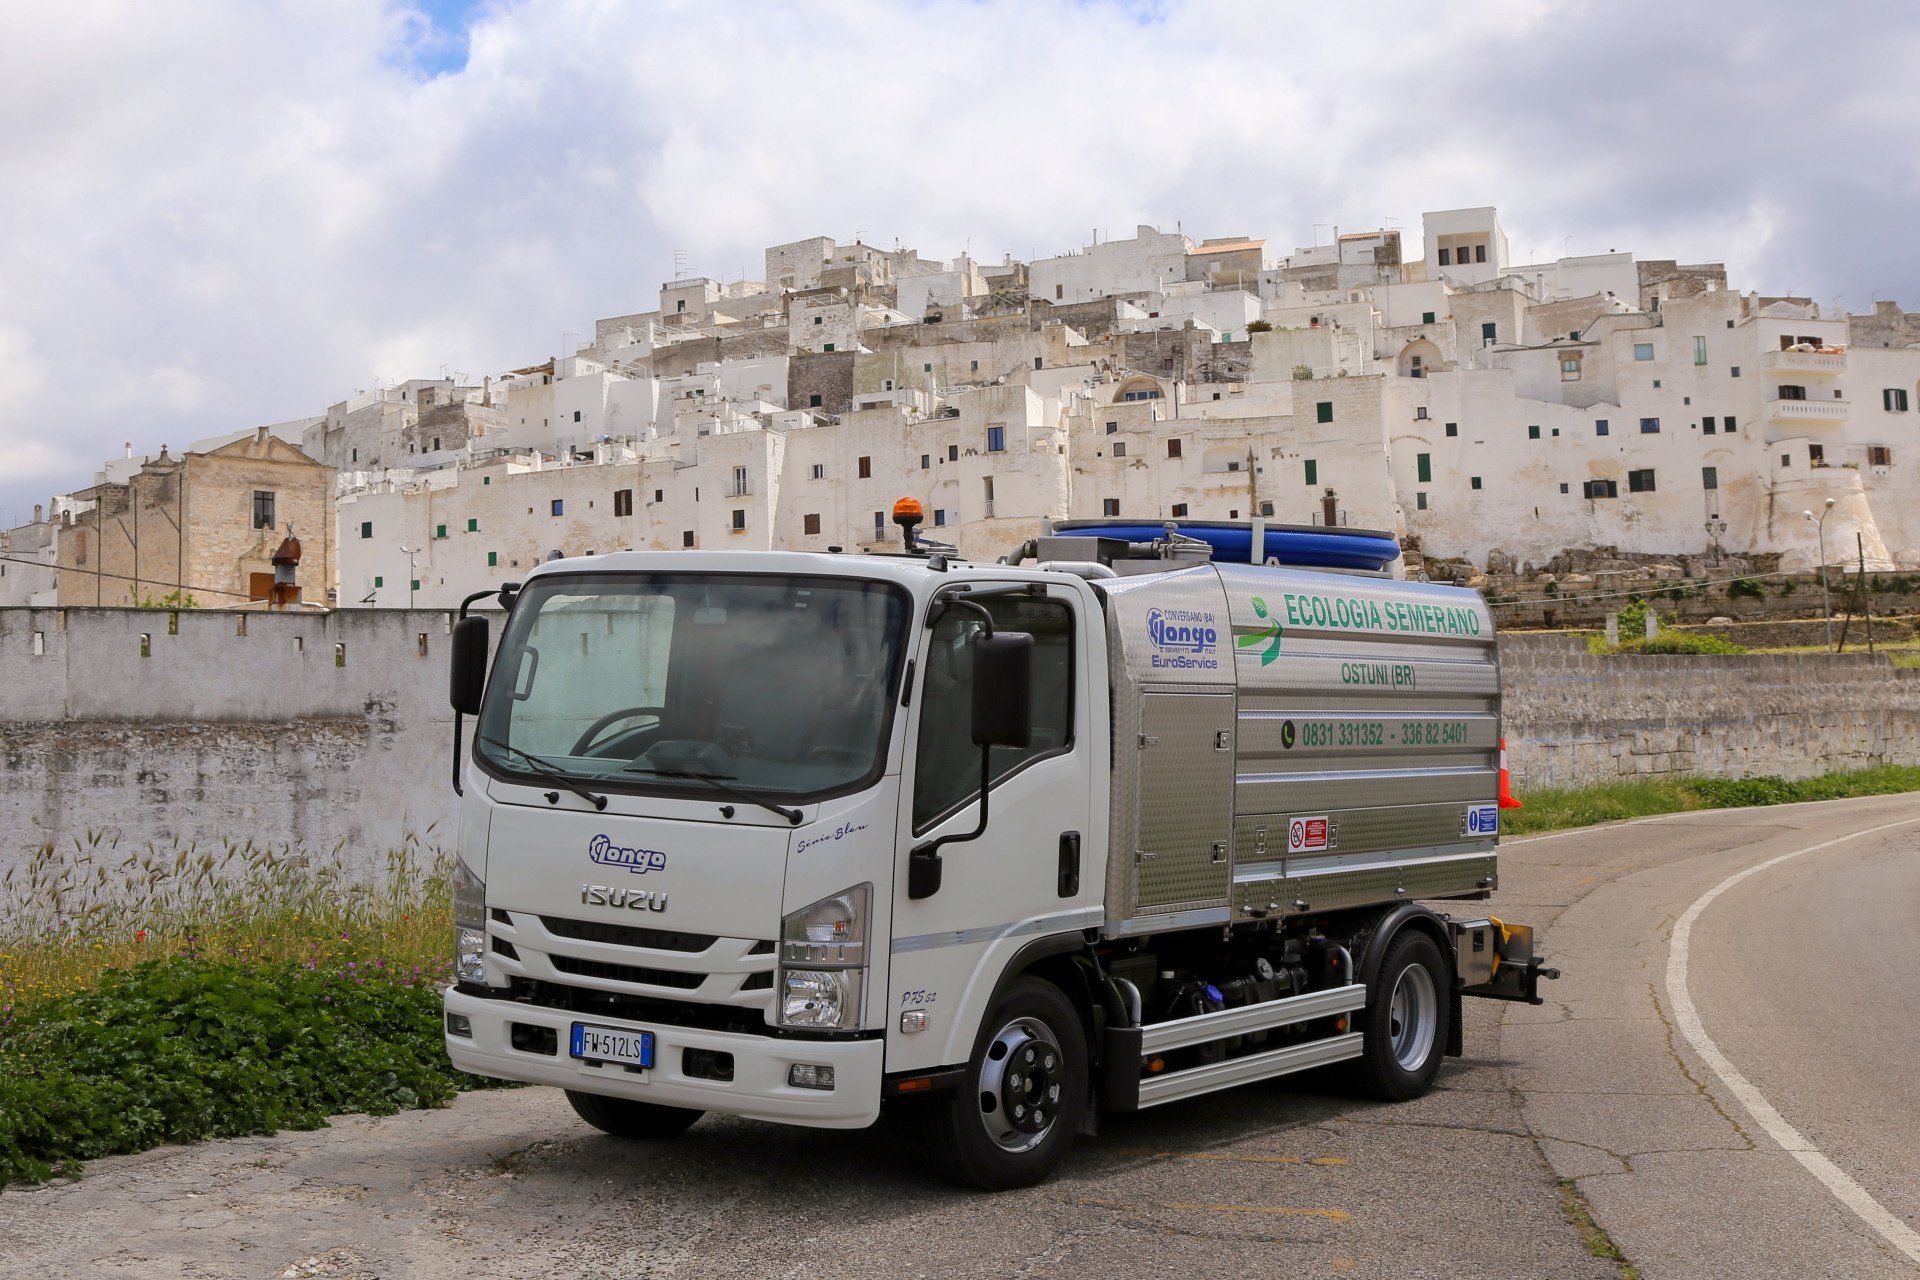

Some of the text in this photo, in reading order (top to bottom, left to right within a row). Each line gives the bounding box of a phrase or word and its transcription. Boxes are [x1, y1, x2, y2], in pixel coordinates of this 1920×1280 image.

[1164, 610, 1203, 622] CONVERSANO
[1283, 593, 1480, 636] ECOLOGIA SEMERANO
[1152, 654, 1218, 669] EuroService
[1341, 662, 1416, 690] OSTUNI (BR)
[1303, 722, 1333, 746] 0831
[1339, 722, 1384, 746] 331352
[1401, 722, 1422, 745] 336
[1425, 722, 1439, 744] 82
[1442, 722, 1467, 744] 5401
[581, 883, 668, 913] ISUZU
